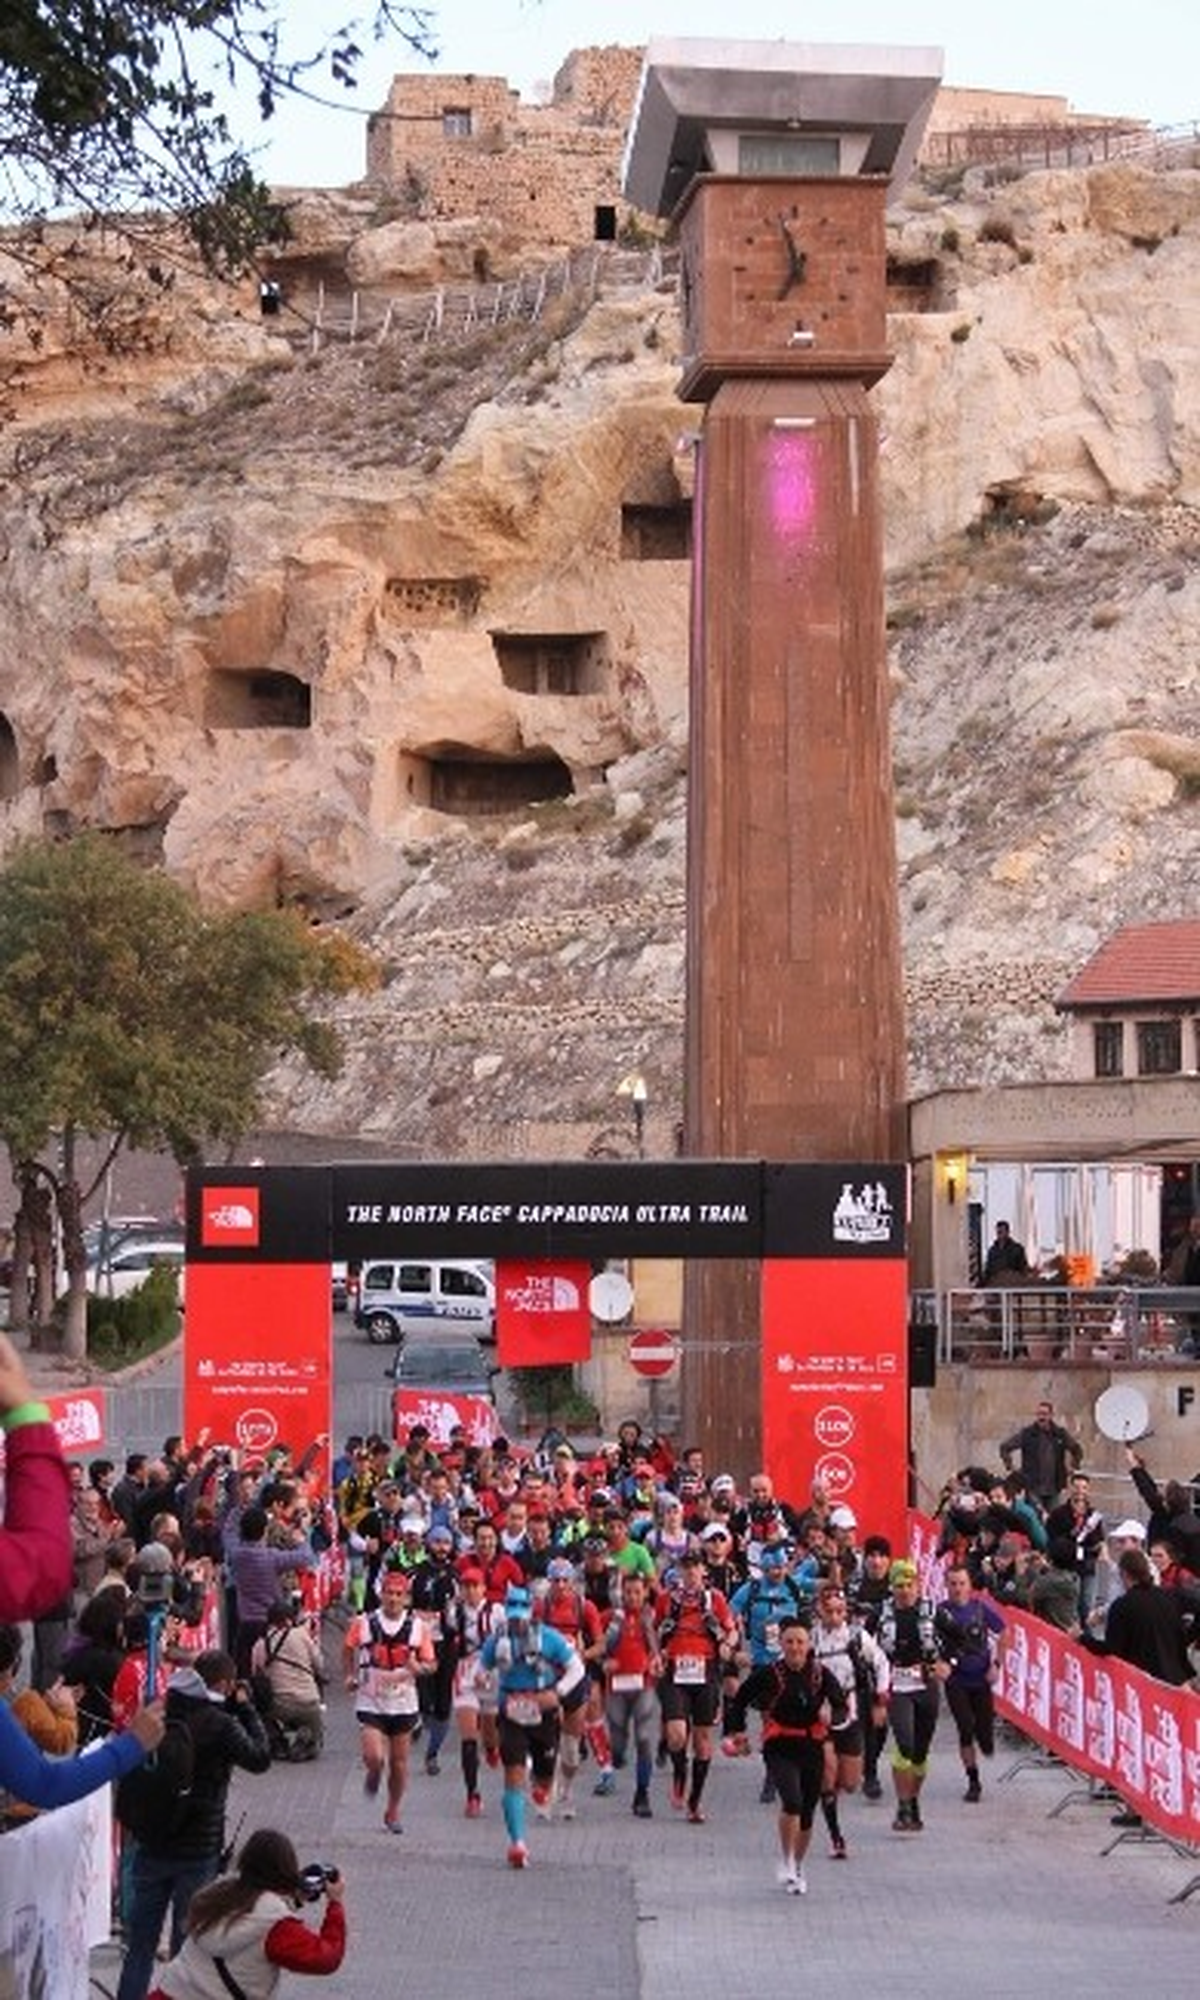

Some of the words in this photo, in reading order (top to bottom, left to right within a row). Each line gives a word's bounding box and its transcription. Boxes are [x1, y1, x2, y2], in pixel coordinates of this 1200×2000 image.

[348, 1205, 383, 1222] THE
[387, 1205, 450, 1222] NORTH
[517, 1205, 629, 1222] CAPPADOCIA
[636, 1205, 691, 1222] ULTRA
[699, 1205, 748, 1222] TRAIL
[1178, 1386, 1195, 1417] F
